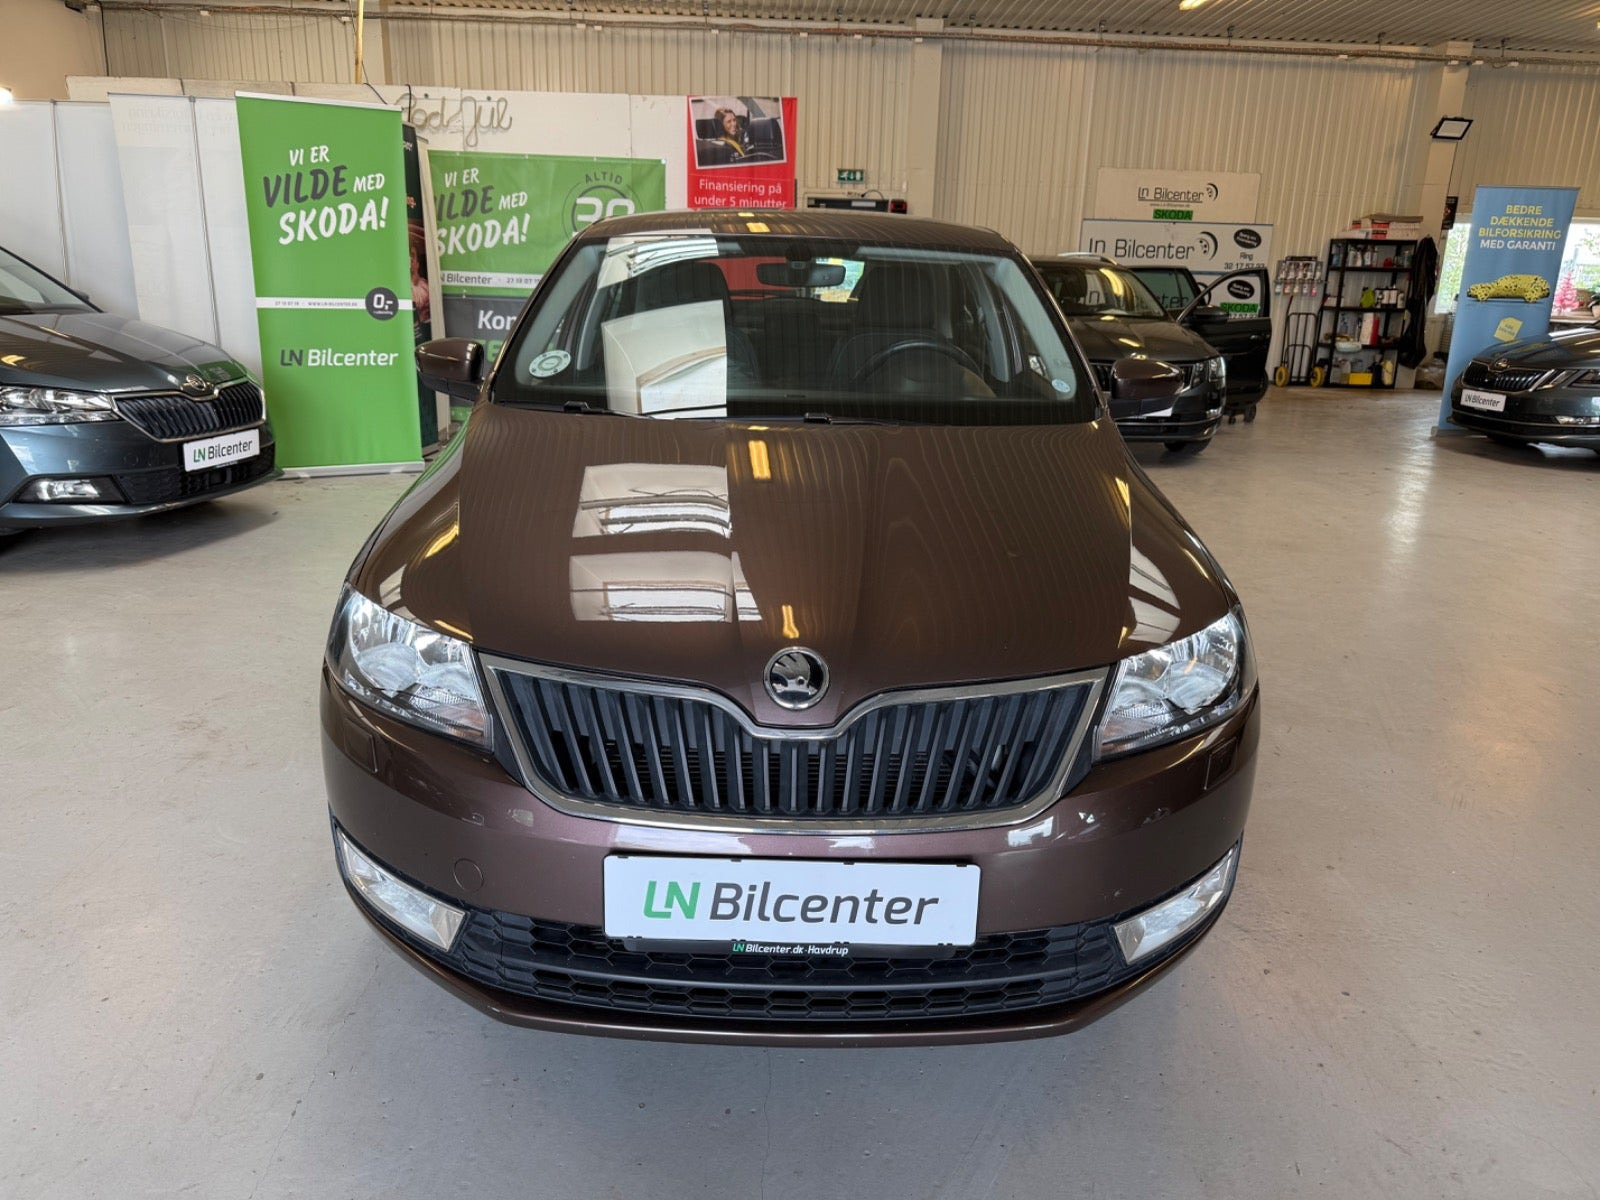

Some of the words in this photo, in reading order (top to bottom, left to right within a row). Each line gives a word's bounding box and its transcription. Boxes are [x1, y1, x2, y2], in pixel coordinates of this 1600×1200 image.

[290, 149, 304, 166] VI
[310, 146, 330, 163] ER
[263, 165, 348, 208] VILDE
[353, 173, 385, 193] MED
[445, 171, 457, 188] VI
[463, 168, 480, 184] ER
[585, 171, 622, 185] ALTID
[699, 178, 765, 195] Finansiering
[768, 183, 782, 196] på
[694, 195, 727, 207] under
[729, 197, 736, 207] 5
[739, 198, 787, 208] minutter
[1153, 187, 1204, 201] Bilcenter
[434, 185, 495, 222] ILDE
[498, 191, 528, 211] MED
[1506, 205, 1543, 215] BEDRE
[279, 196, 389, 245] SKODA!
[1153, 209, 1192, 220] SKODA
[1490, 216, 1555, 227] DÆKKENDE
[437, 212, 531, 257] SKODA!
[1478, 228, 1562, 239] BILFORSIKRING
[1114, 238, 1195, 259] Bilcenter
[1479, 239, 1505, 249] MED
[1507, 240, 1556, 250] GARANTI
[446, 273, 493, 284] Bilcenter
[280, 349, 303, 367] LN
[307, 348, 399, 367] Bilcenter
[193, 447, 206, 463] LN
[207, 440, 253, 460] Bilcenter
[643, 880, 701, 920] LN
[709, 881, 940, 926] Bilcenter
[732, 943, 745, 952] LN
